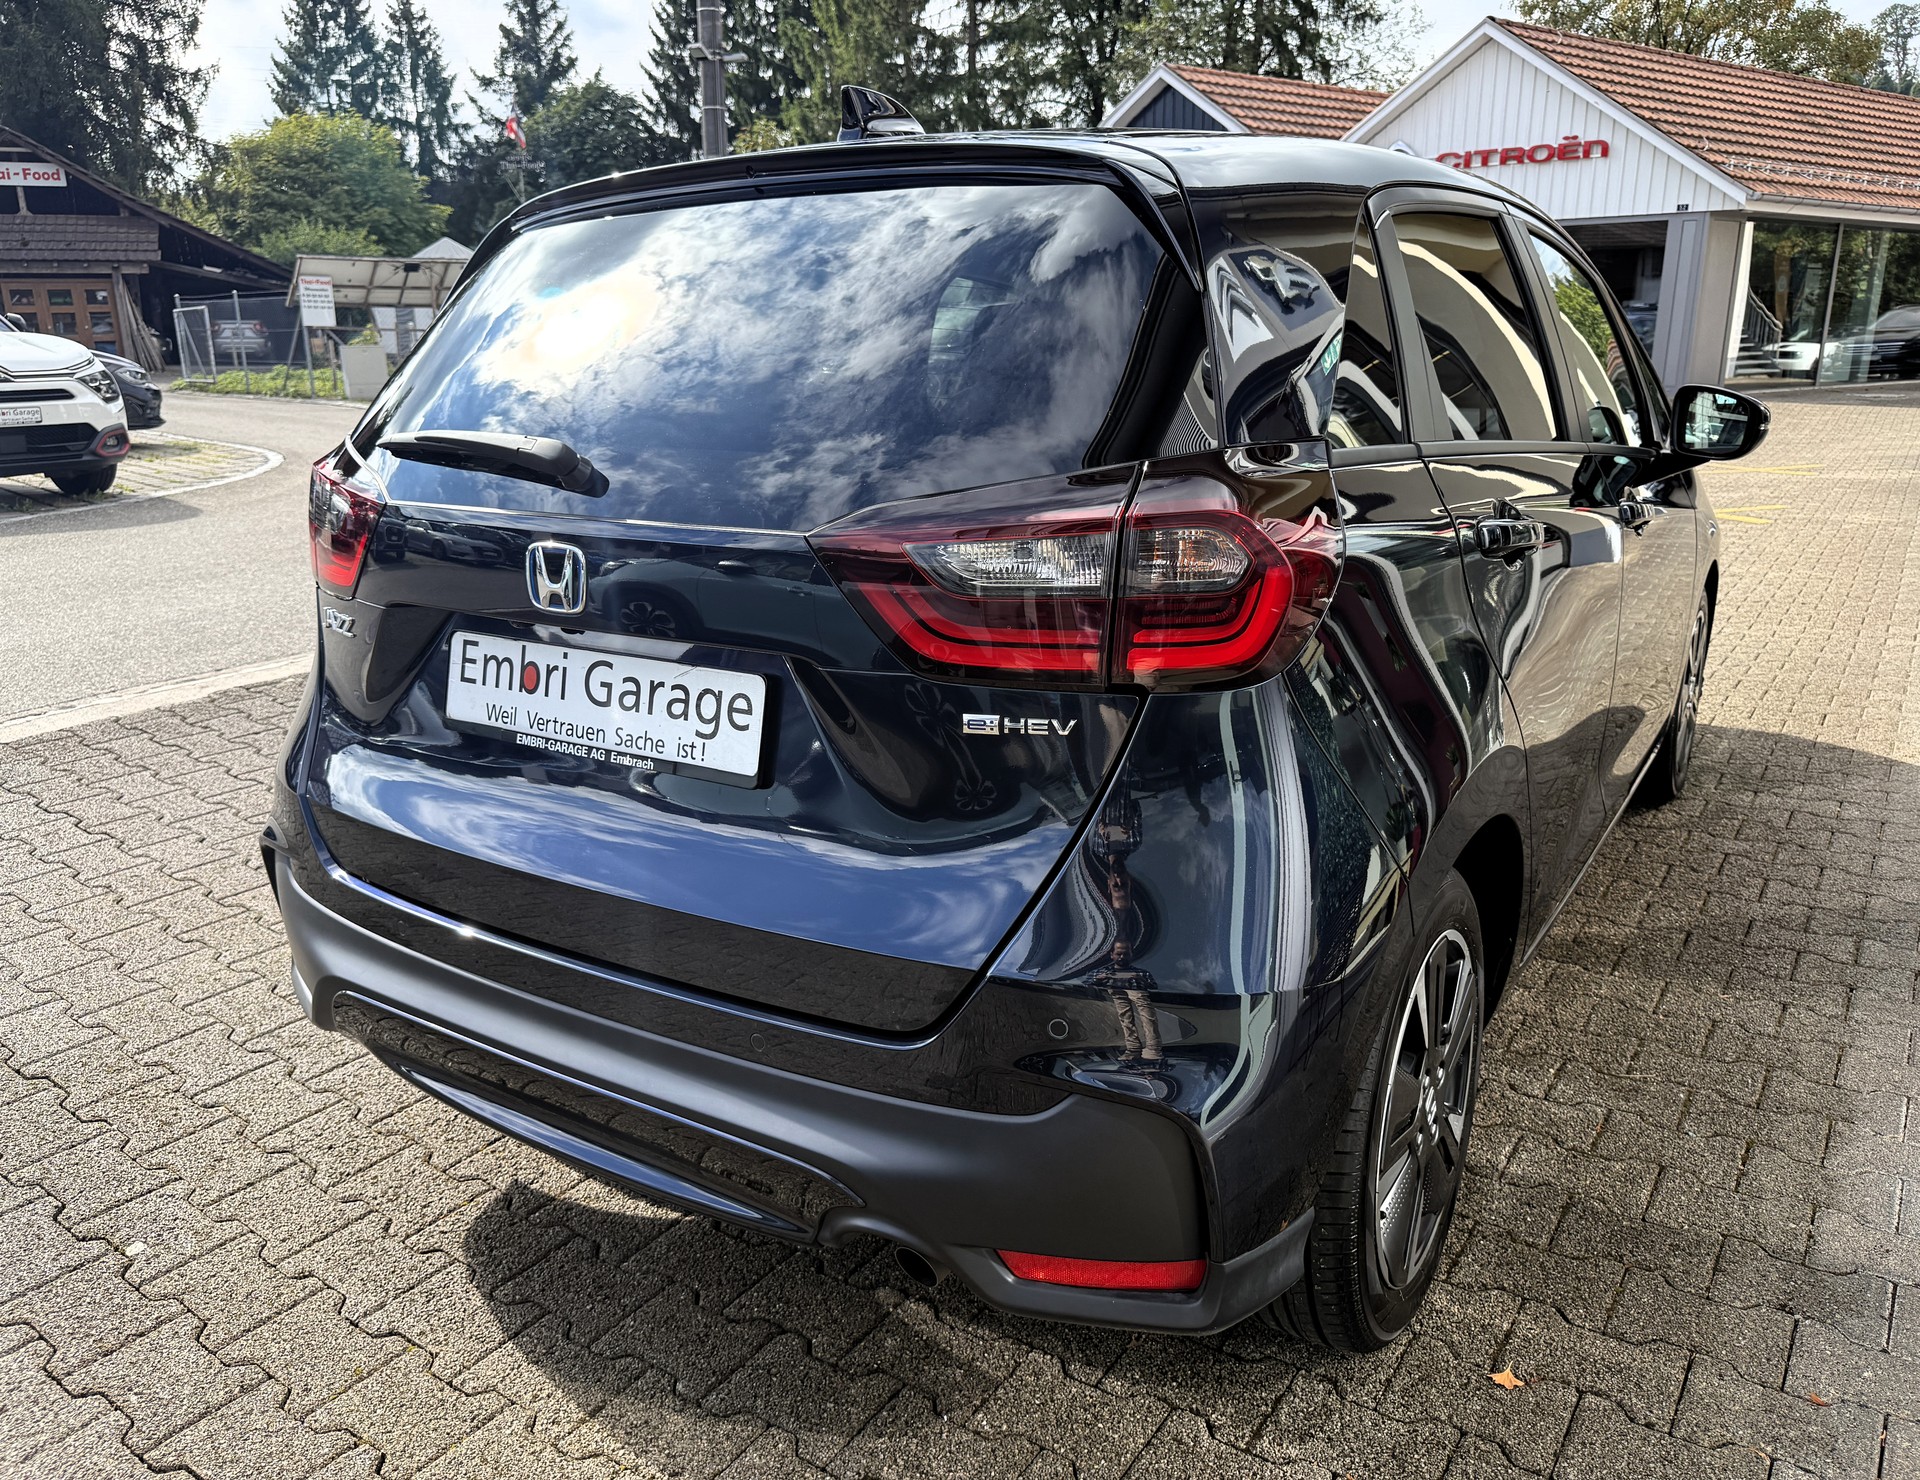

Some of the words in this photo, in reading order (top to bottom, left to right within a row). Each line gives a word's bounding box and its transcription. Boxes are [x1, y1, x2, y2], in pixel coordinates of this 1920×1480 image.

[460, 639, 569, 701] Embri
[584, 660, 753, 740] Garage
[486, 702, 518, 726] Weil
[527, 710, 606, 743] Vertrauen
[614, 727, 666, 754] Sache
[516, 733, 589, 758] EMBRI-GARAGE
[590, 747, 606, 761] AG
[610, 752, 654, 770] Embrach
